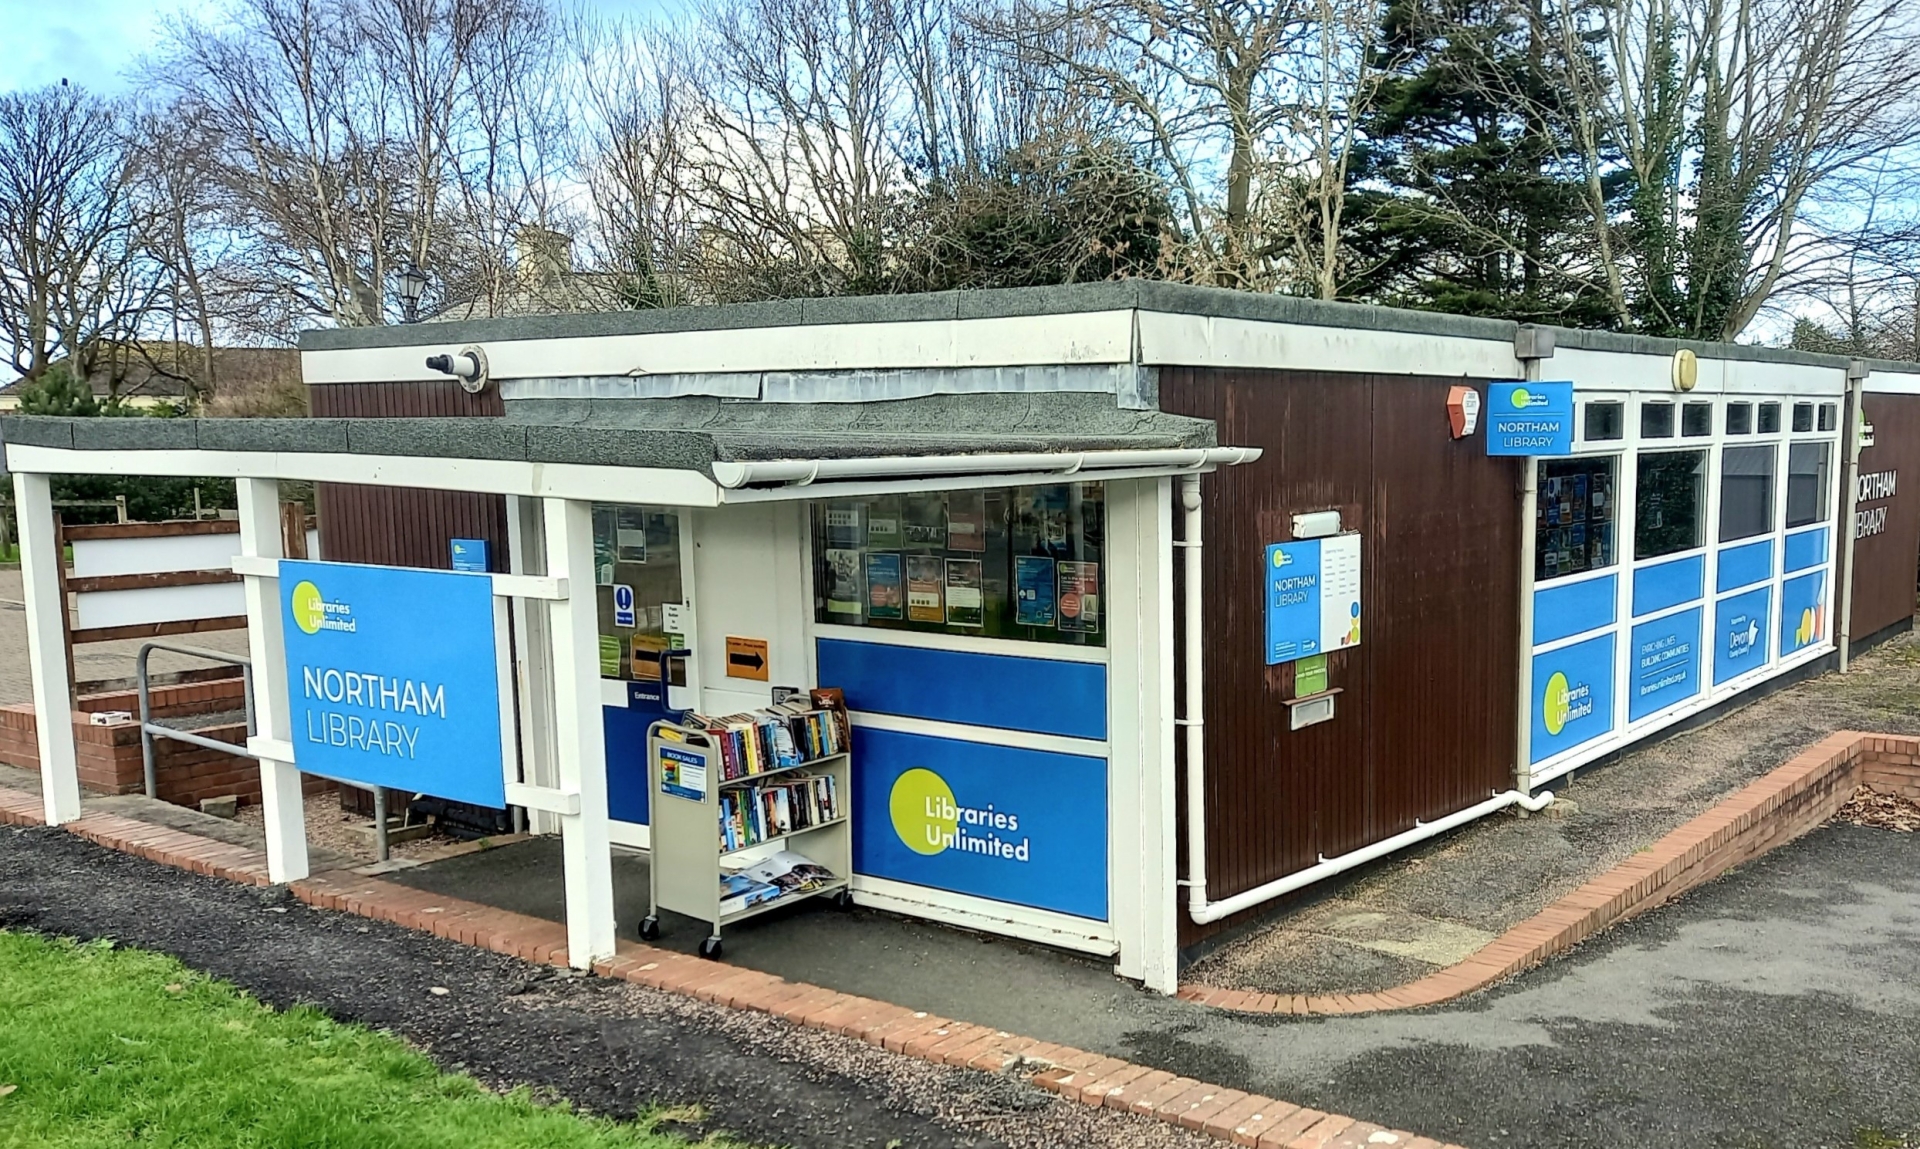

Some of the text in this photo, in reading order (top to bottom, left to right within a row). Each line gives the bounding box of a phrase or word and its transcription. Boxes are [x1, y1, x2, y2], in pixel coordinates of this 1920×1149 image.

[1498, 422, 1560, 433] NORTHAM
[1503, 436, 1554, 447] LIBRARY
[1275, 574, 1316, 593] NORTHAM
[308, 598, 350, 615] Libraries
[1275, 590, 1309, 608] LIBRARY
[309, 615, 356, 632] Unlimited
[1730, 631, 1749, 649] Devon
[1641, 642, 1690, 669] BUILDING COMMUNITIES
[303, 665, 446, 719] NORTHAM
[634, 691, 660, 701] Entrance
[1557, 682, 1589, 706] Libraries
[1556, 697, 1592, 726] Unlimited
[307, 709, 420, 759] LIBRARY
[666, 751, 698, 764] BOOK SALES
[925, 796, 1019, 831] Libraries
[925, 824, 1030, 862] Unlimited
